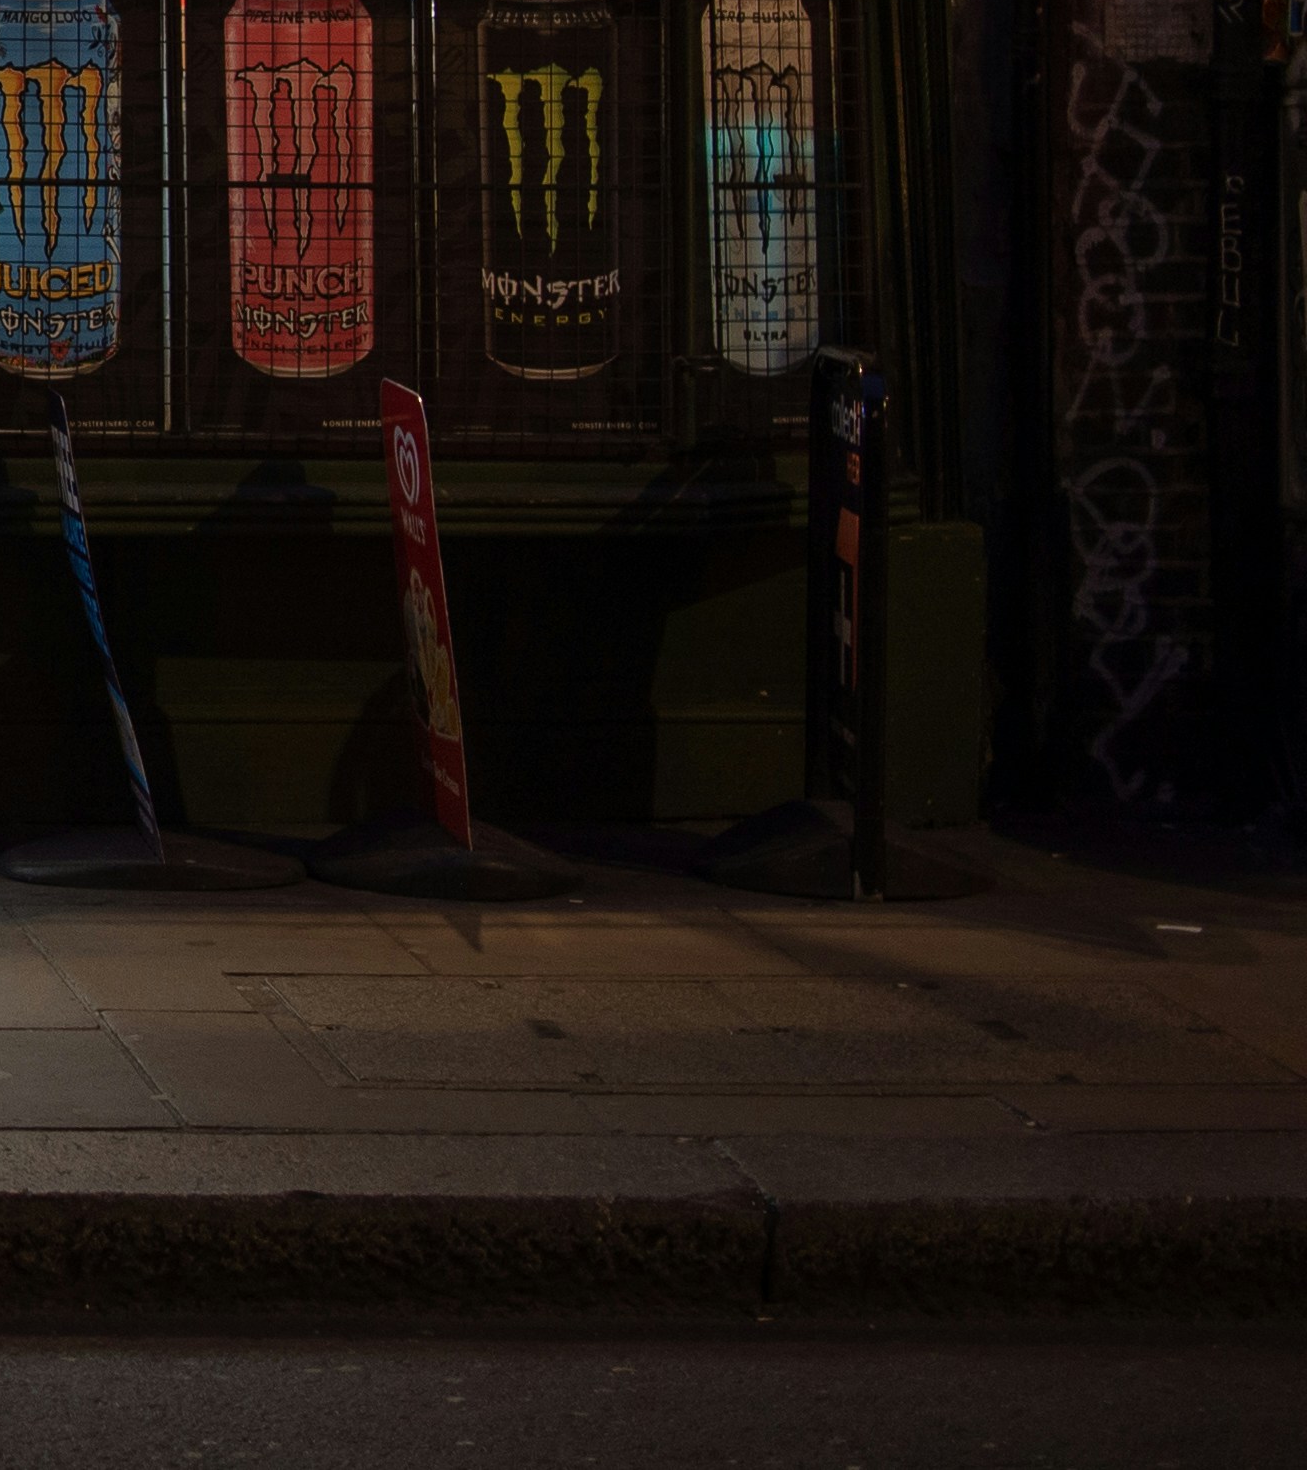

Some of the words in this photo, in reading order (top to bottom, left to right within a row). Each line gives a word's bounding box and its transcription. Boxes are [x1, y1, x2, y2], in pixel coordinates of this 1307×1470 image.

[1, 11, 49, 23] MANGO
[56, 10, 93, 23] LOCO
[240, 258, 365, 301] PUNCH
[481, 268, 621, 310] MONSTER
[236, 300, 369, 340] MONSTER
[495, 307, 608, 327] ENERGY
[743, 330, 788, 341] ULTRA
